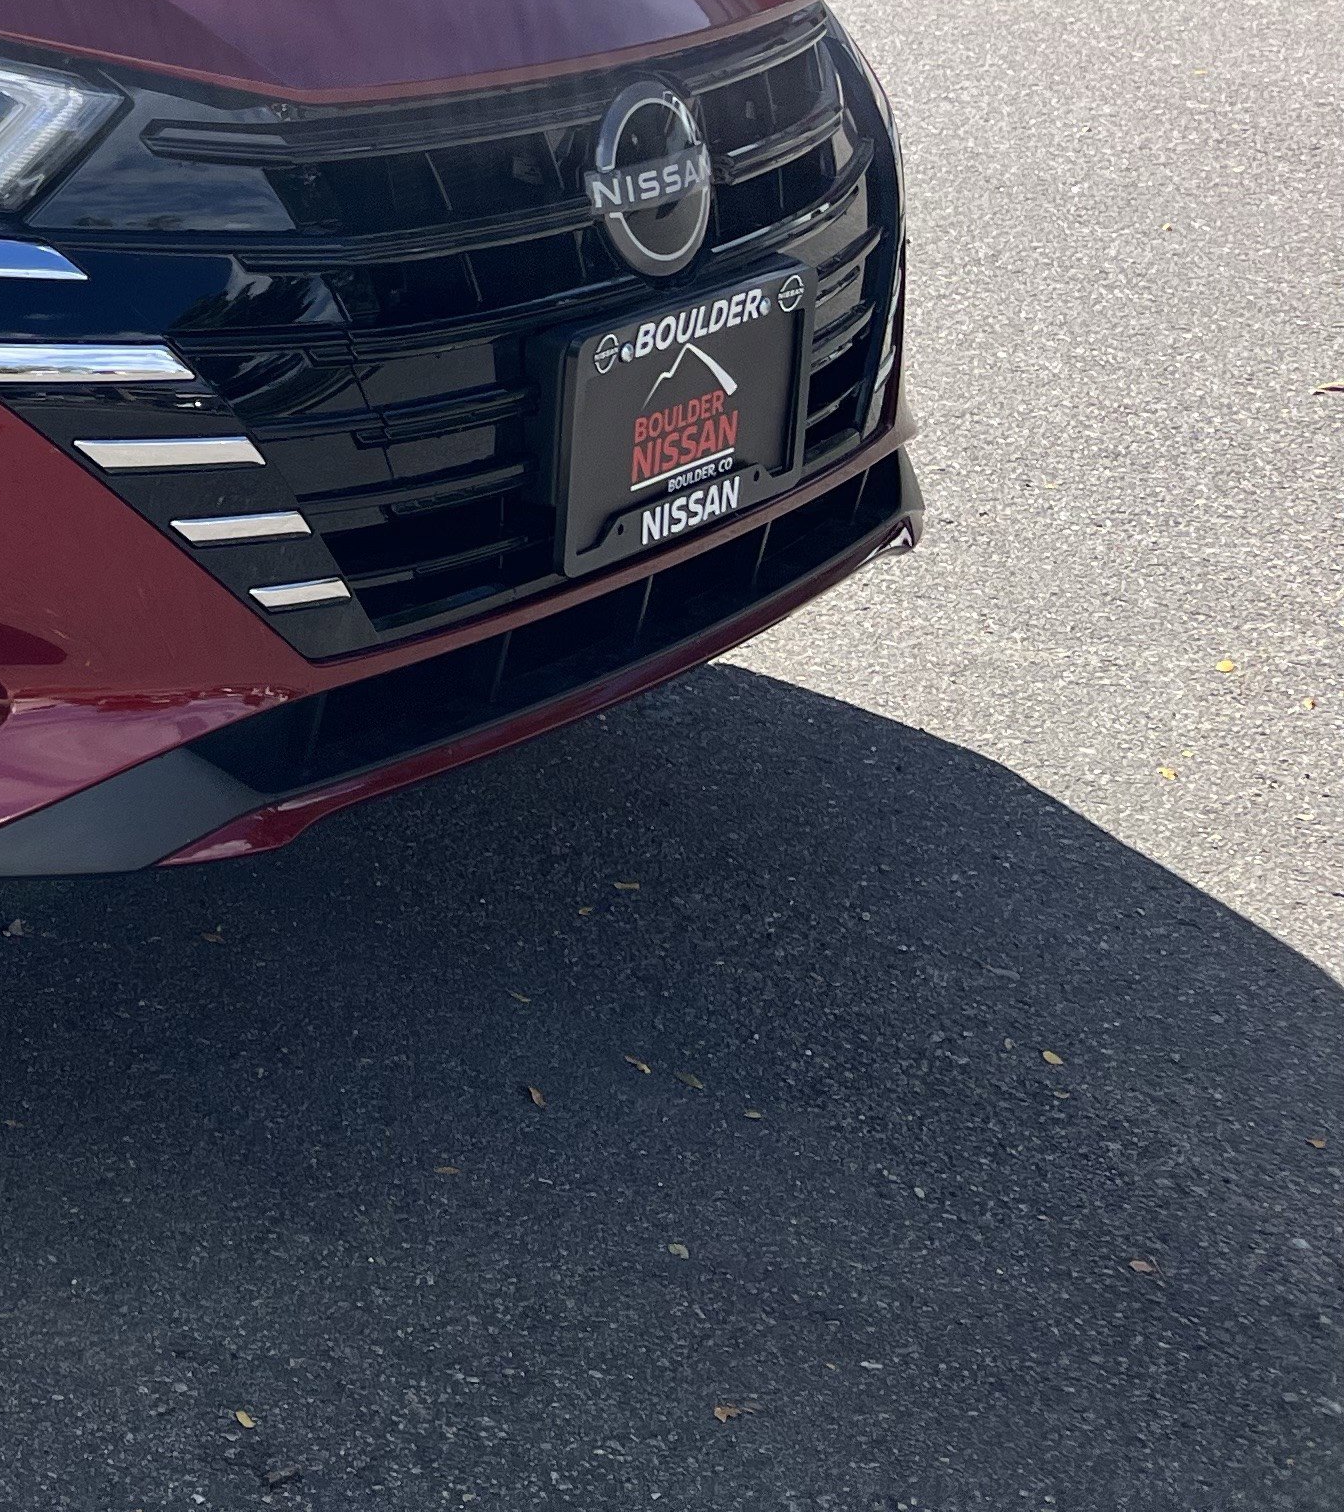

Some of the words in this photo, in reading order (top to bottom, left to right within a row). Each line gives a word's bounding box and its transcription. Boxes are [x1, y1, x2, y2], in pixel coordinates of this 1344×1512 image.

[634, 289, 762, 358] BOULDER
[632, 410, 739, 485] NISSAN
[634, 390, 725, 444] BOULDER
[718, 457, 733, 473] CO
[642, 476, 741, 546] NISSAN
